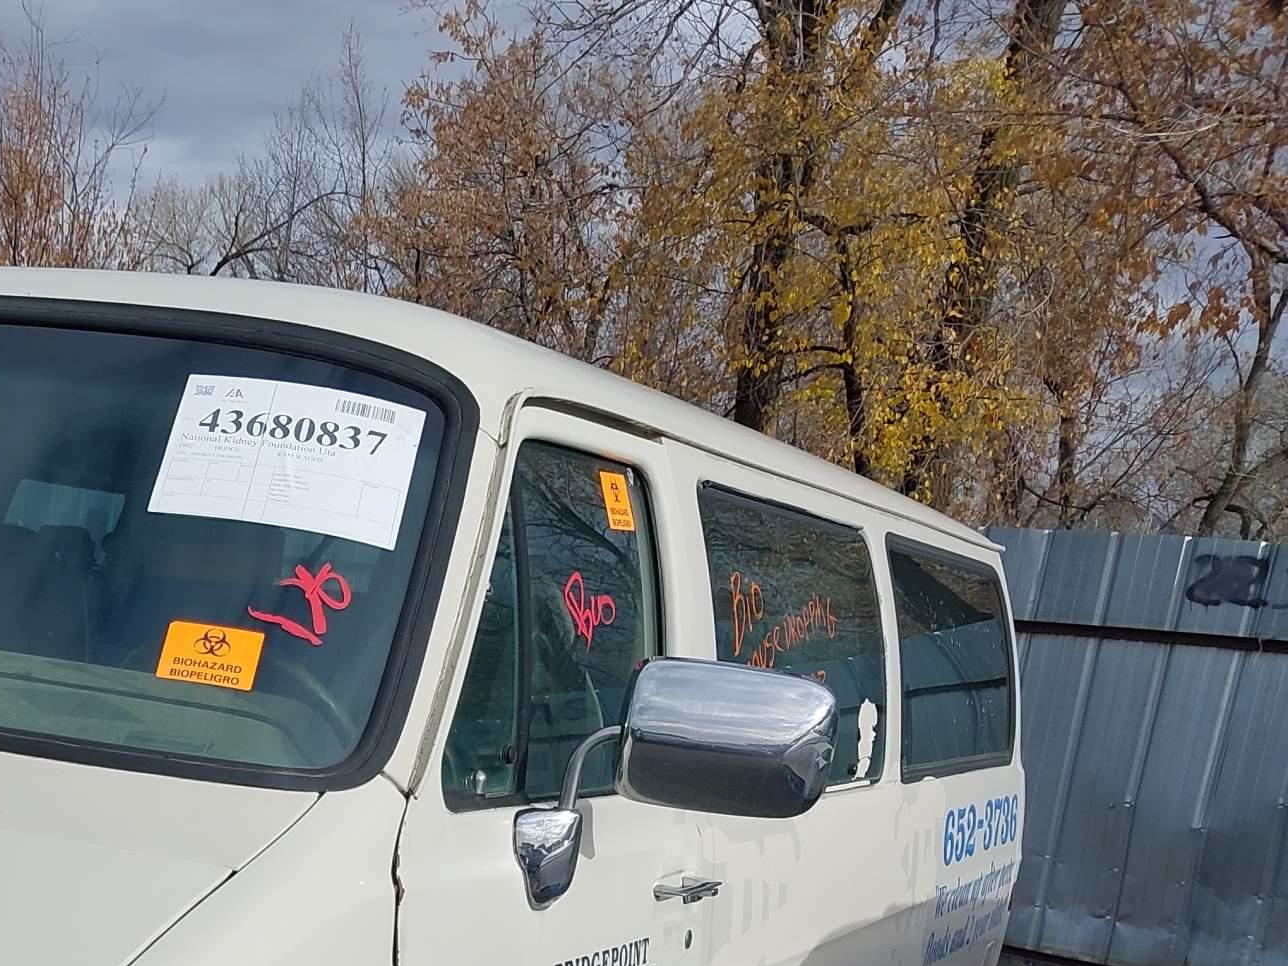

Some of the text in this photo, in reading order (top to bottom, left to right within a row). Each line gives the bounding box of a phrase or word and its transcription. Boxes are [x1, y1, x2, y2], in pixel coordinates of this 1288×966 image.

[198, 407, 388, 456] 43680837
[180, 432, 221, 443] National
[224, 435, 257, 448] Kidney
[262, 439, 316, 453] Foundation
[172, 656, 243, 675] BIOHAZARD
[169, 667, 240, 686] BIOPELIGRO
[943, 793, 1018, 866] 652-3736
